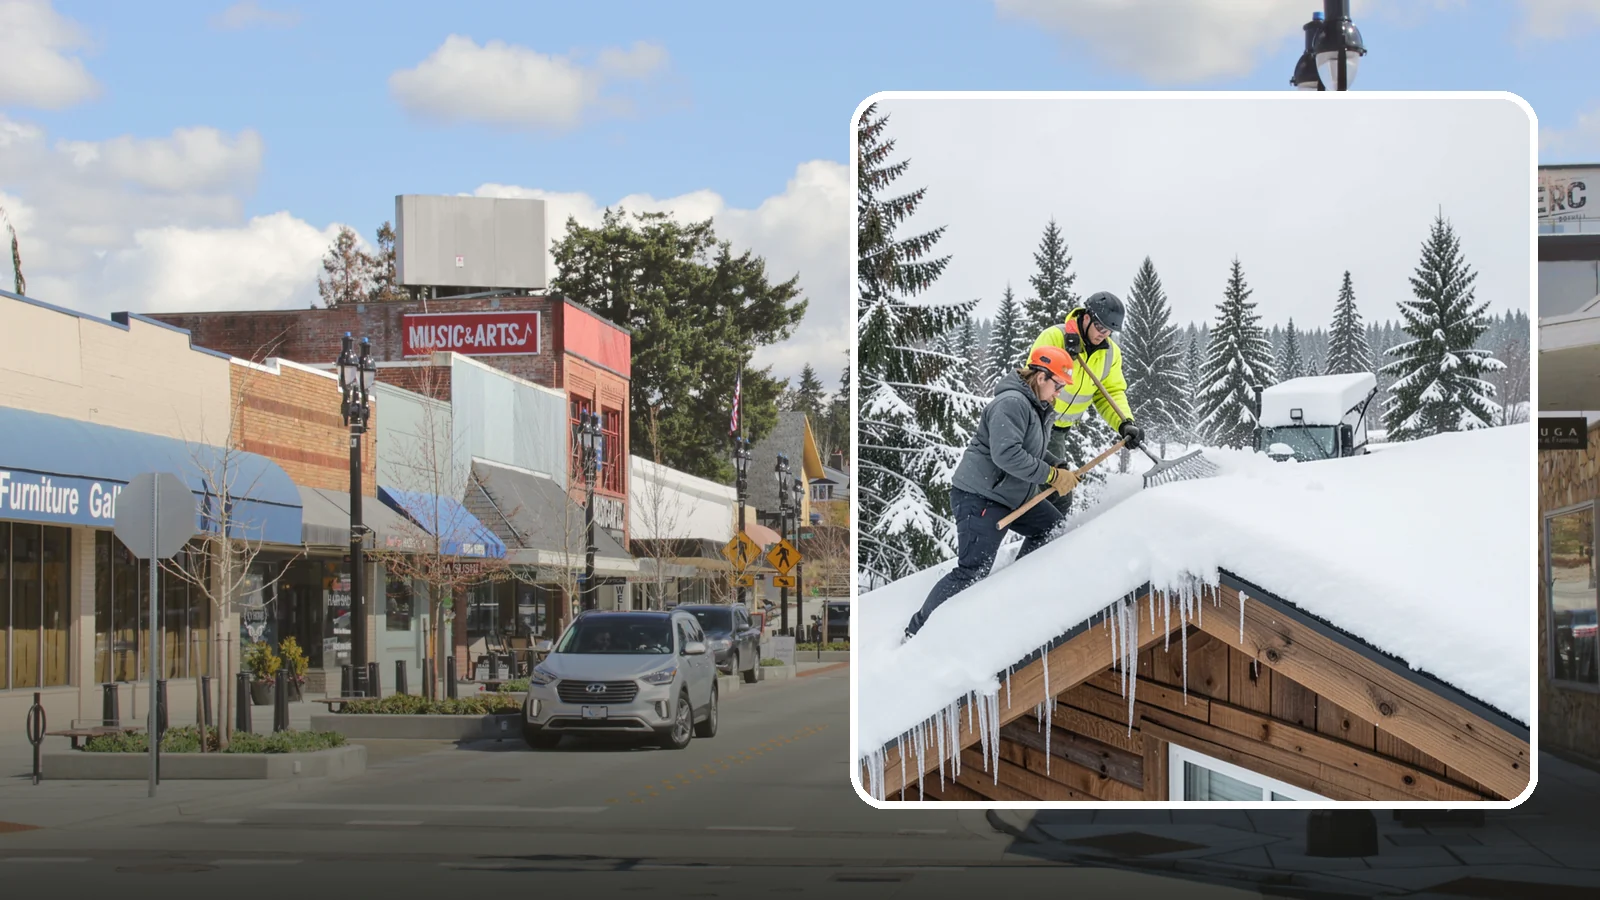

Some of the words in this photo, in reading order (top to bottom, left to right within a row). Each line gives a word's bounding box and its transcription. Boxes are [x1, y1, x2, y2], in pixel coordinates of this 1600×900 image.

[409, 323, 519, 349] MUSIC&ARTS
[0, 471, 79, 515] Furniture
[453, 563, 480, 575] SUSHI
